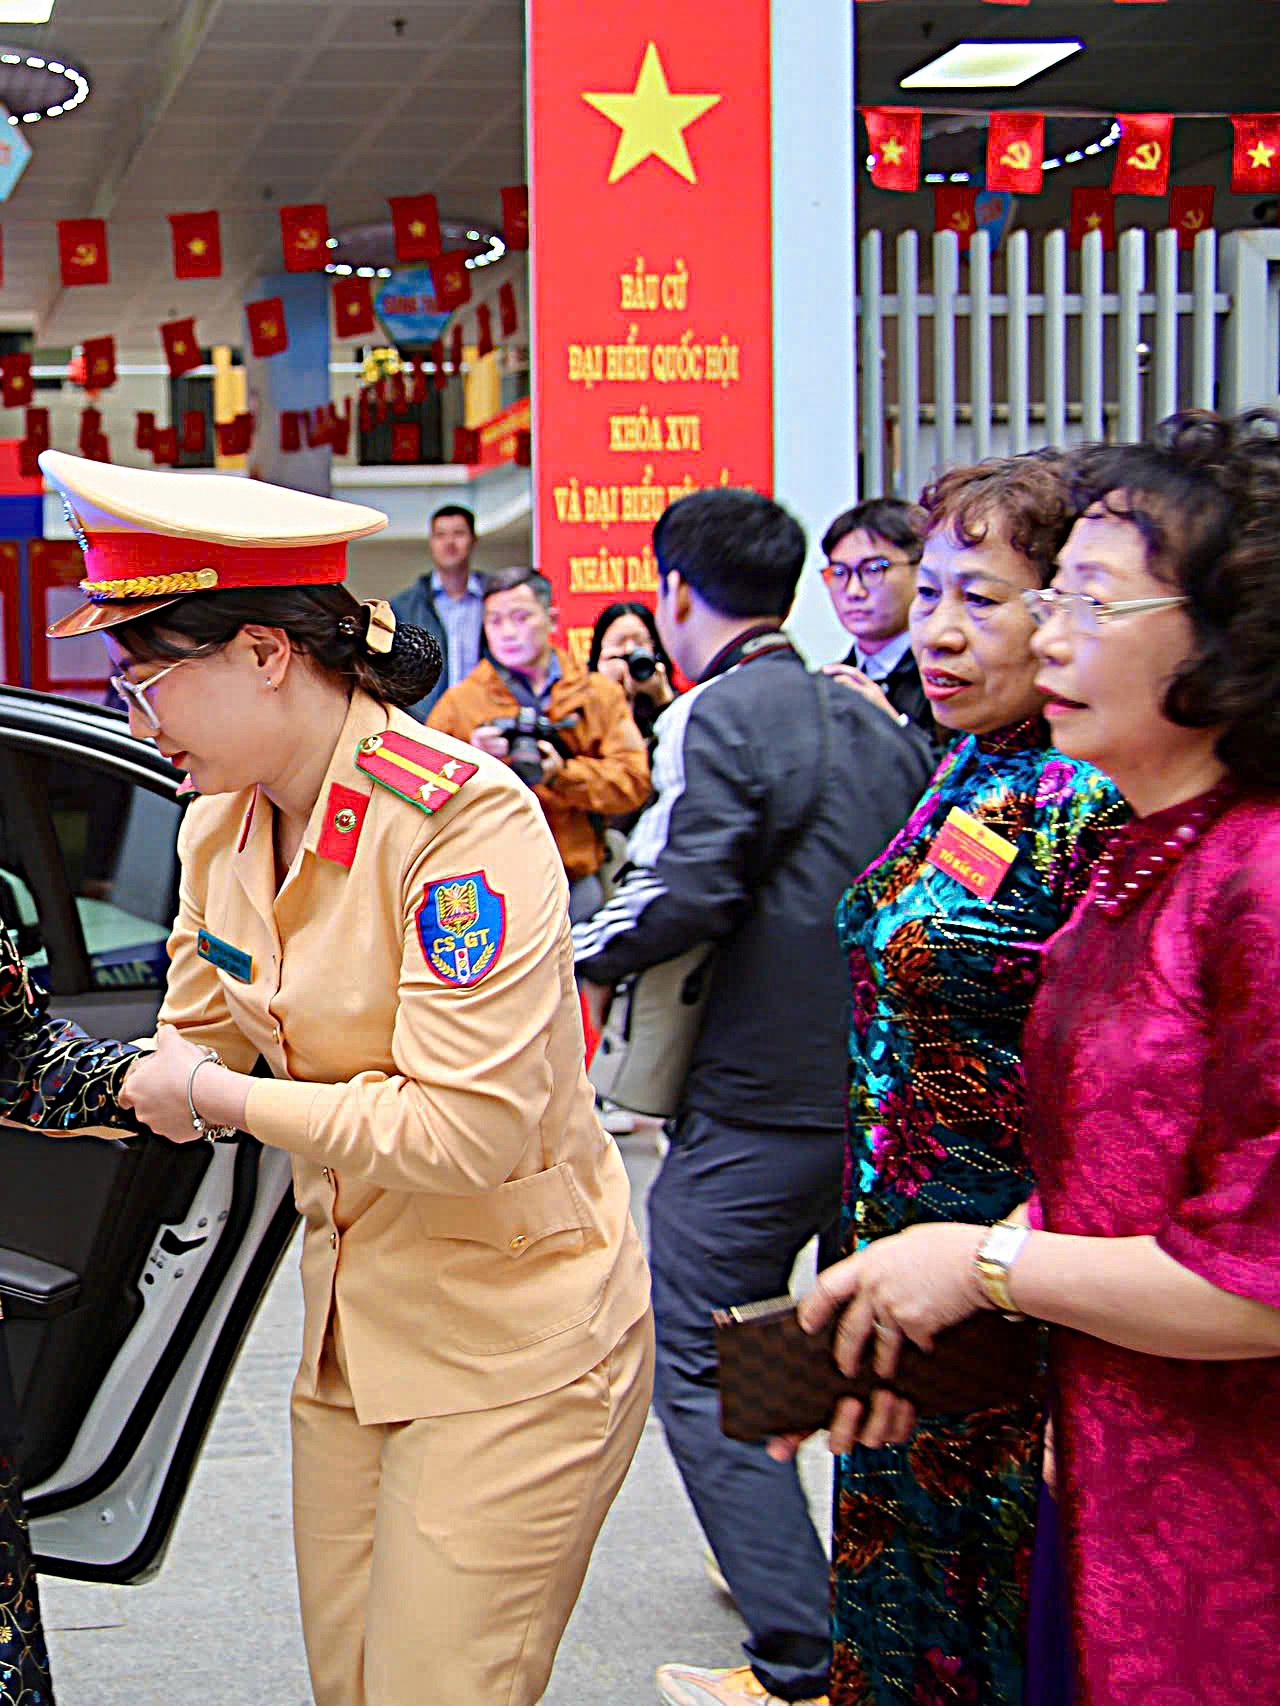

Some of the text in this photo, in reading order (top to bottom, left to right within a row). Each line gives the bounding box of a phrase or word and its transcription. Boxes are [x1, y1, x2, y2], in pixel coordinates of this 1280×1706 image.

[661, 258, 688, 310] CỬ
[568, 322, 739, 389] ĐẠI BIỂU QUỐC HỘI
[609, 404, 701, 451] KHÓA XVI
[553, 476, 582, 521] VÀ
[583, 487, 618, 531] ĐẠI
[570, 545, 659, 592] NHÂN DÂ
[433, 927, 490, 954] CS GT
